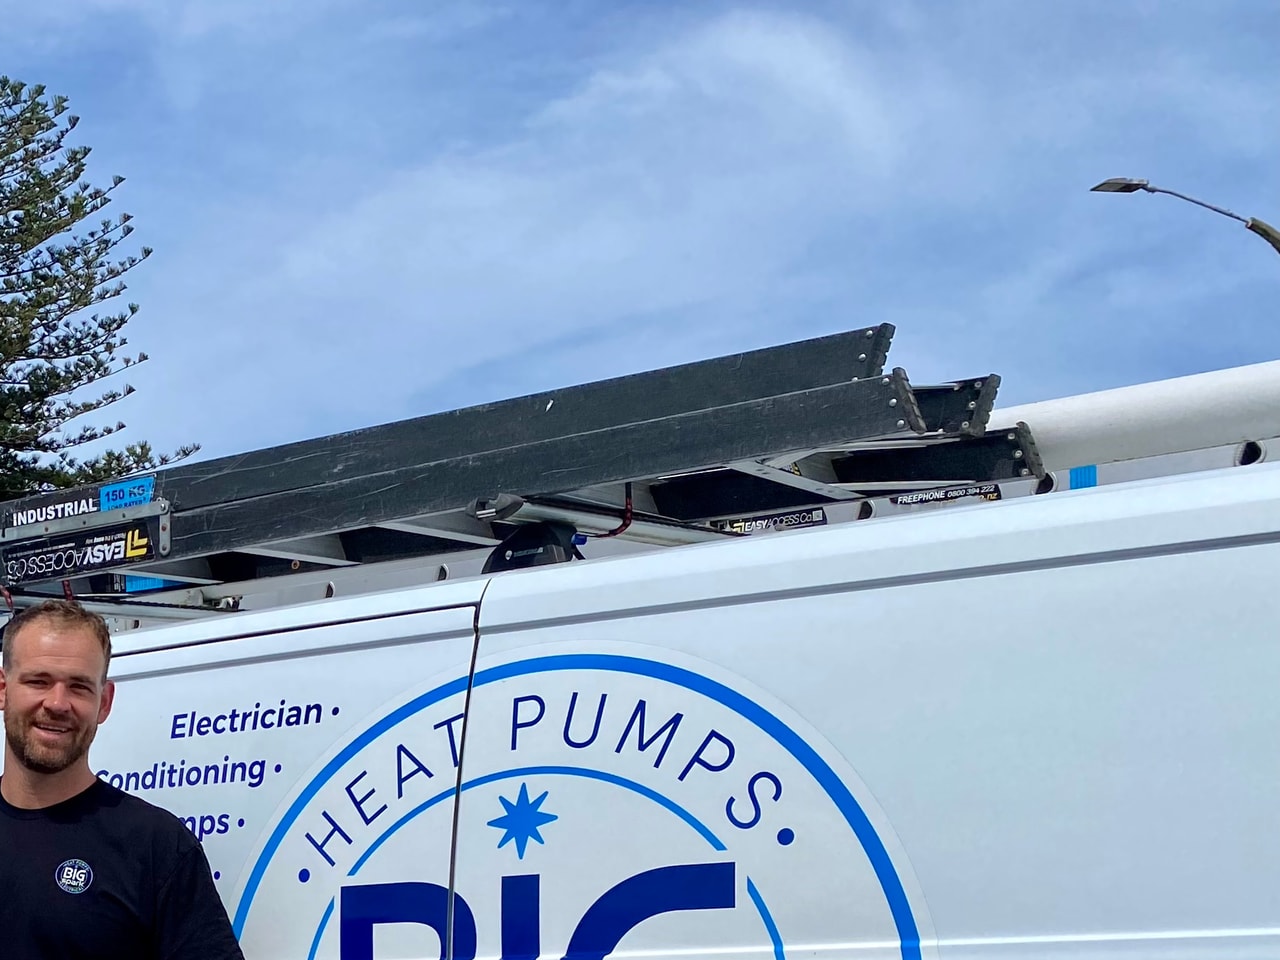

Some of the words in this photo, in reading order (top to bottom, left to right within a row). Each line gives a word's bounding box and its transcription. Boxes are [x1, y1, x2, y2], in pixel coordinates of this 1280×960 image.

[13, 498, 97, 526] INDUSTRIAL
[105, 489, 125, 502] 150
[129, 485, 145, 498] KG
[897, 490, 945, 504] FREEPHONE
[947, 489, 965, 498] 0800
[170, 699, 322, 739] Electrician
[305, 713, 465, 866] HEAT
[511, 691, 783, 830] PUMPS
[63, 866, 87, 881] BIG
